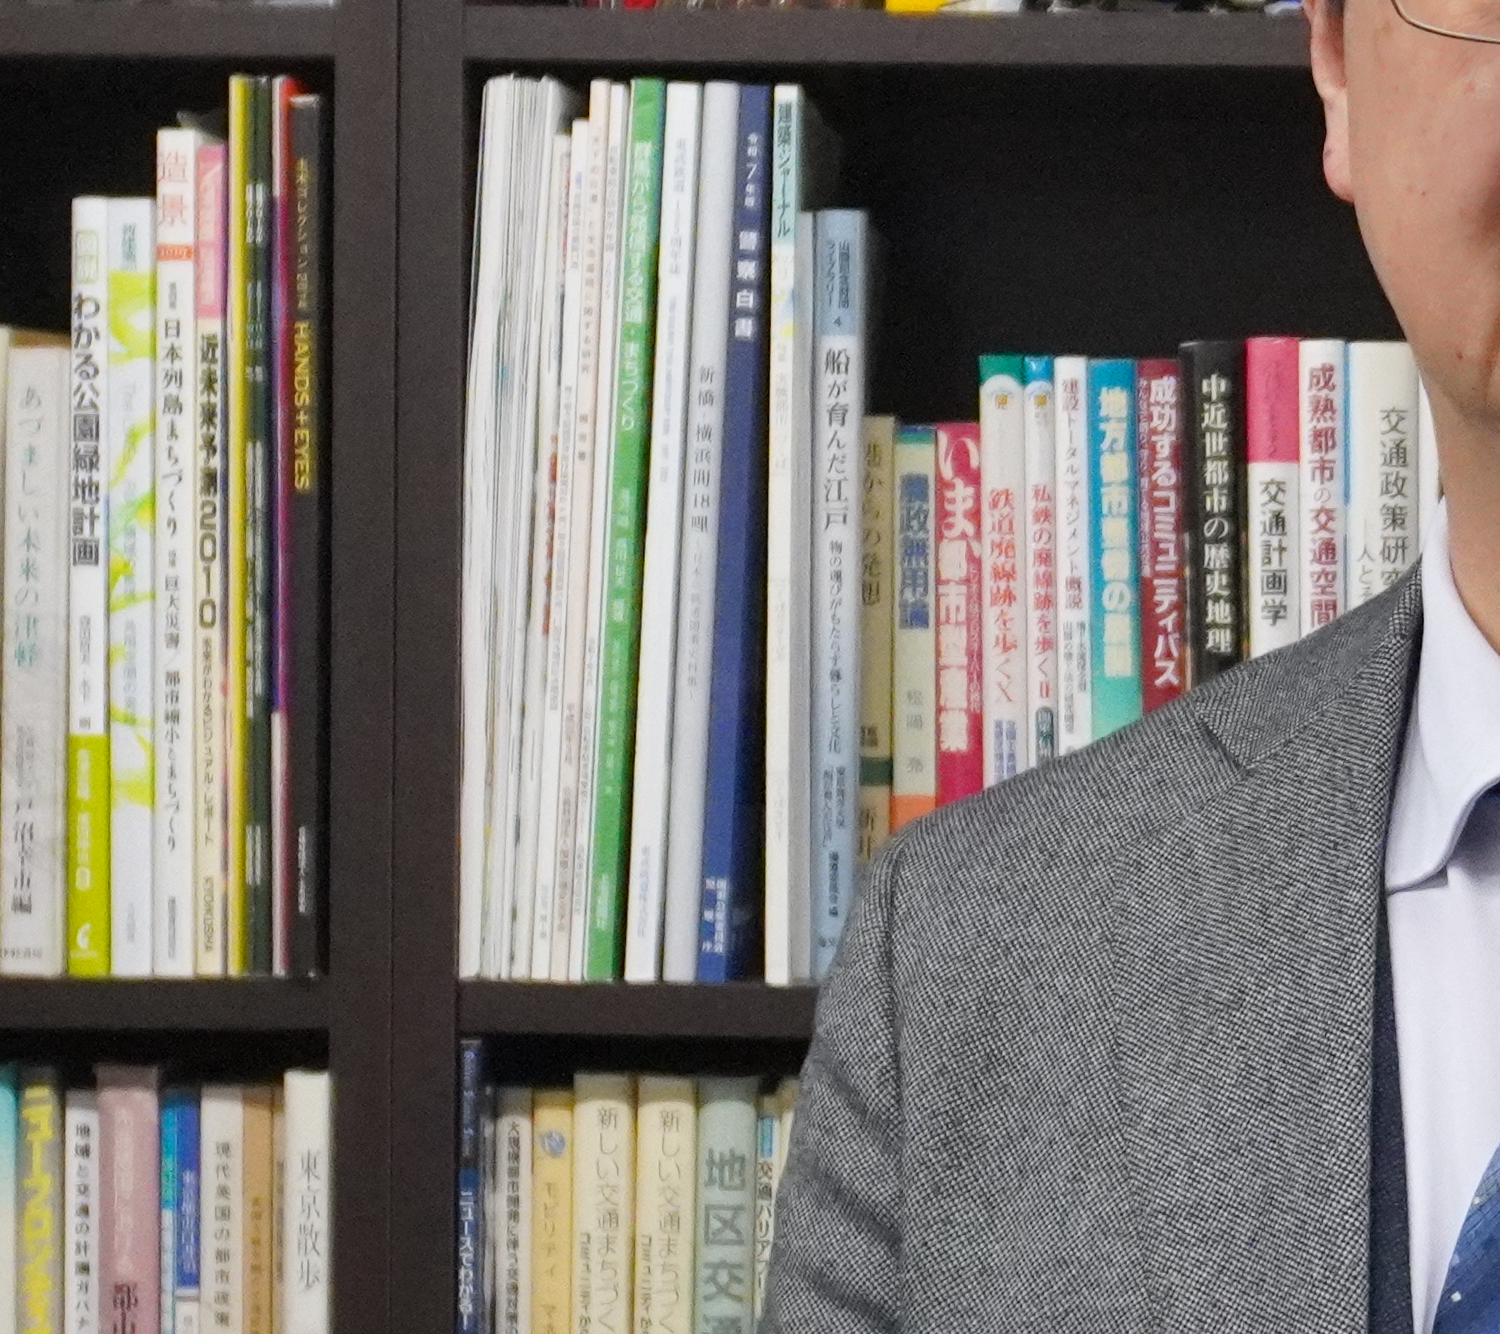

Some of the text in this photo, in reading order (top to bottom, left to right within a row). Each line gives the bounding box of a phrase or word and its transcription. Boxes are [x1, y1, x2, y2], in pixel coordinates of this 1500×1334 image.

[822, 347, 851, 531] 船が育んだ江戸
[1149, 375, 1180, 687] 成功するコミュニティバス
[1200, 375, 1233, 654] 中近世都市の歴史地理
[1259, 477, 1287, 627] 交通計画学
[1308, 362, 1337, 624] 成熟都市の交通空間
